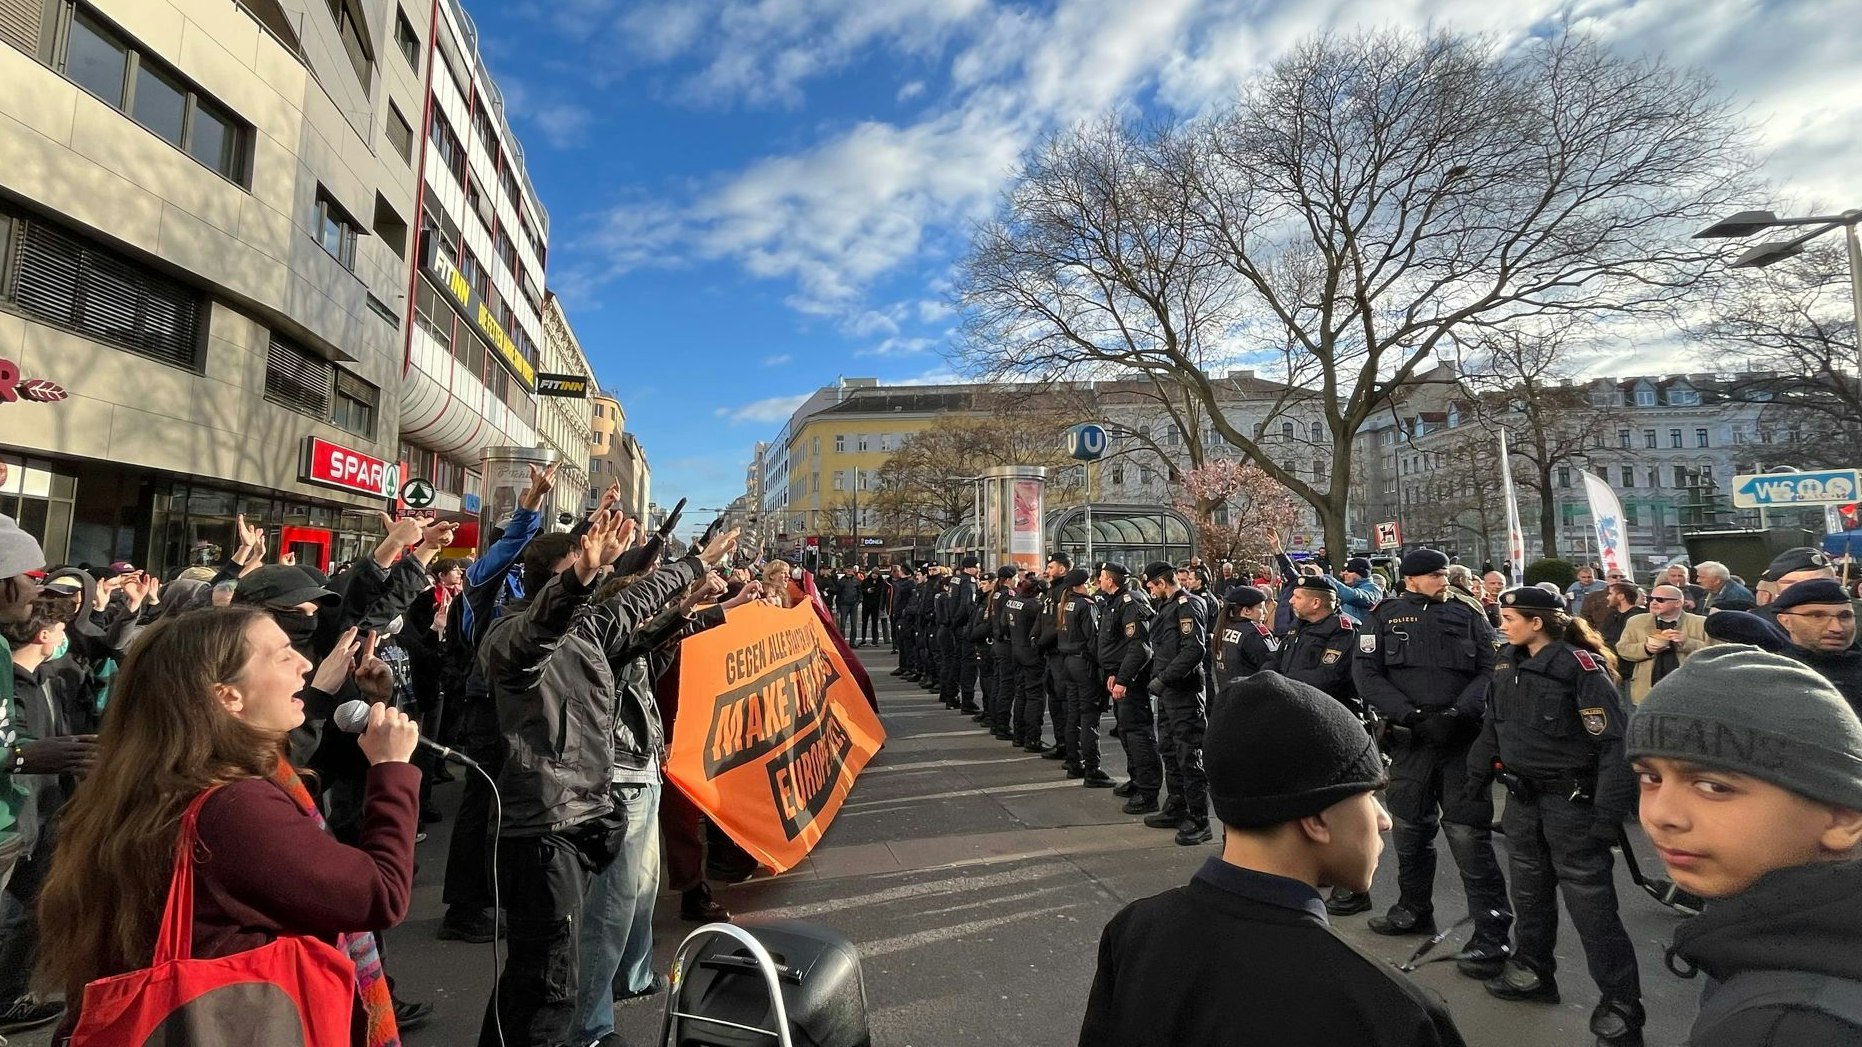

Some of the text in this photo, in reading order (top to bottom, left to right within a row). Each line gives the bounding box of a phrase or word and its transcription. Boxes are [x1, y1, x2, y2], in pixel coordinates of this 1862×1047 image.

[1067, 432, 1077, 455] U
[1084, 432, 1103, 453] U
[330, 450, 383, 489] SPAR
[399, 509, 434, 518] SPAR
[1388, 616, 1418, 624] POLIZEI
[726, 639, 767, 685] GEGEN
[768, 631, 788, 664] ALLE
[711, 677, 791, 763] MAKE
